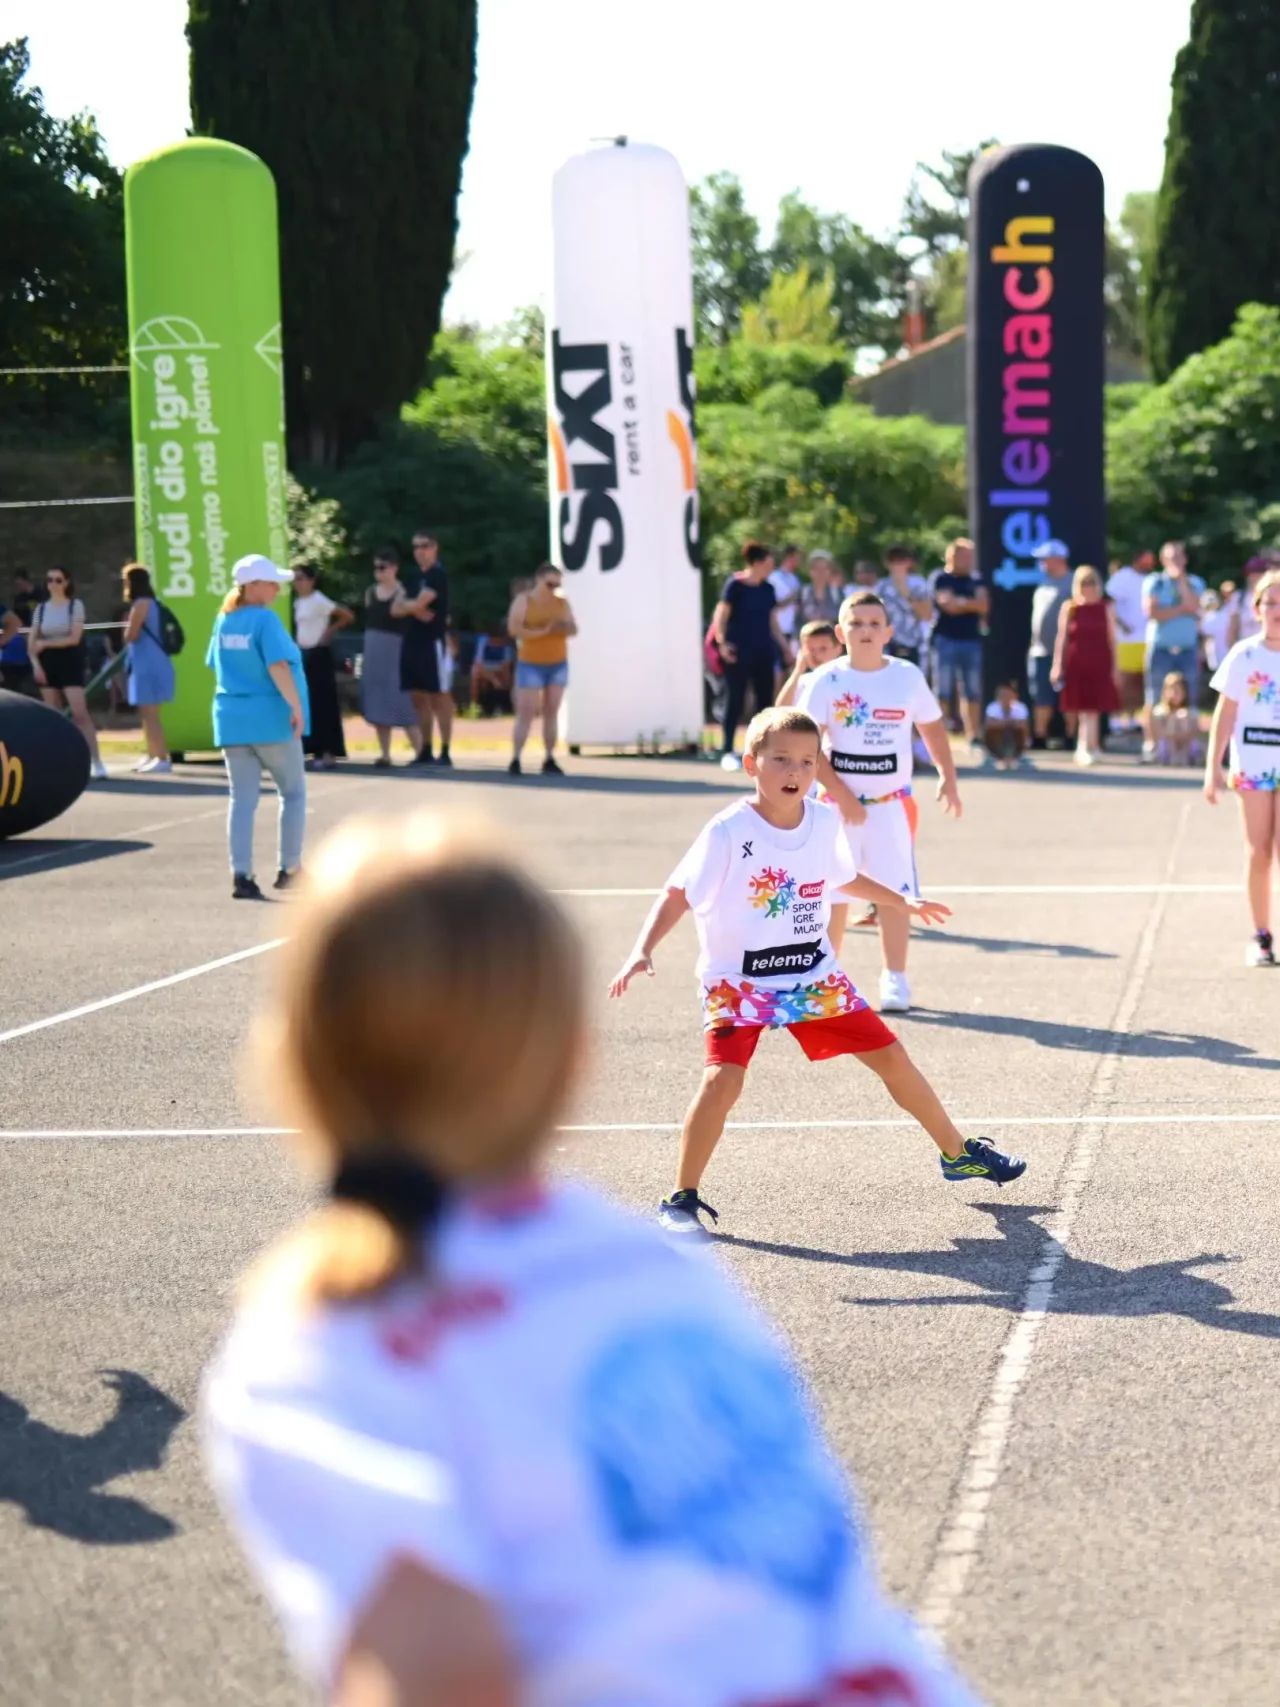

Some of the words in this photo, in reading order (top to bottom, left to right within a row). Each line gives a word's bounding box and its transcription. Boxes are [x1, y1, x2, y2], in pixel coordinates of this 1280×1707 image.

[150, 354, 190, 430] igre
[186, 353, 220, 435] planet
[619, 341, 636, 386] car
[623, 396, 636, 410] a
[990, 215, 1055, 592] telemach
[153, 440, 186, 501] dio
[552, 328, 625, 572] SIXT
[621, 419, 641, 476] rent
[157, 512, 196, 597] budi
[834, 757, 893, 771] telemach
[793, 914, 815, 924] IGRE
